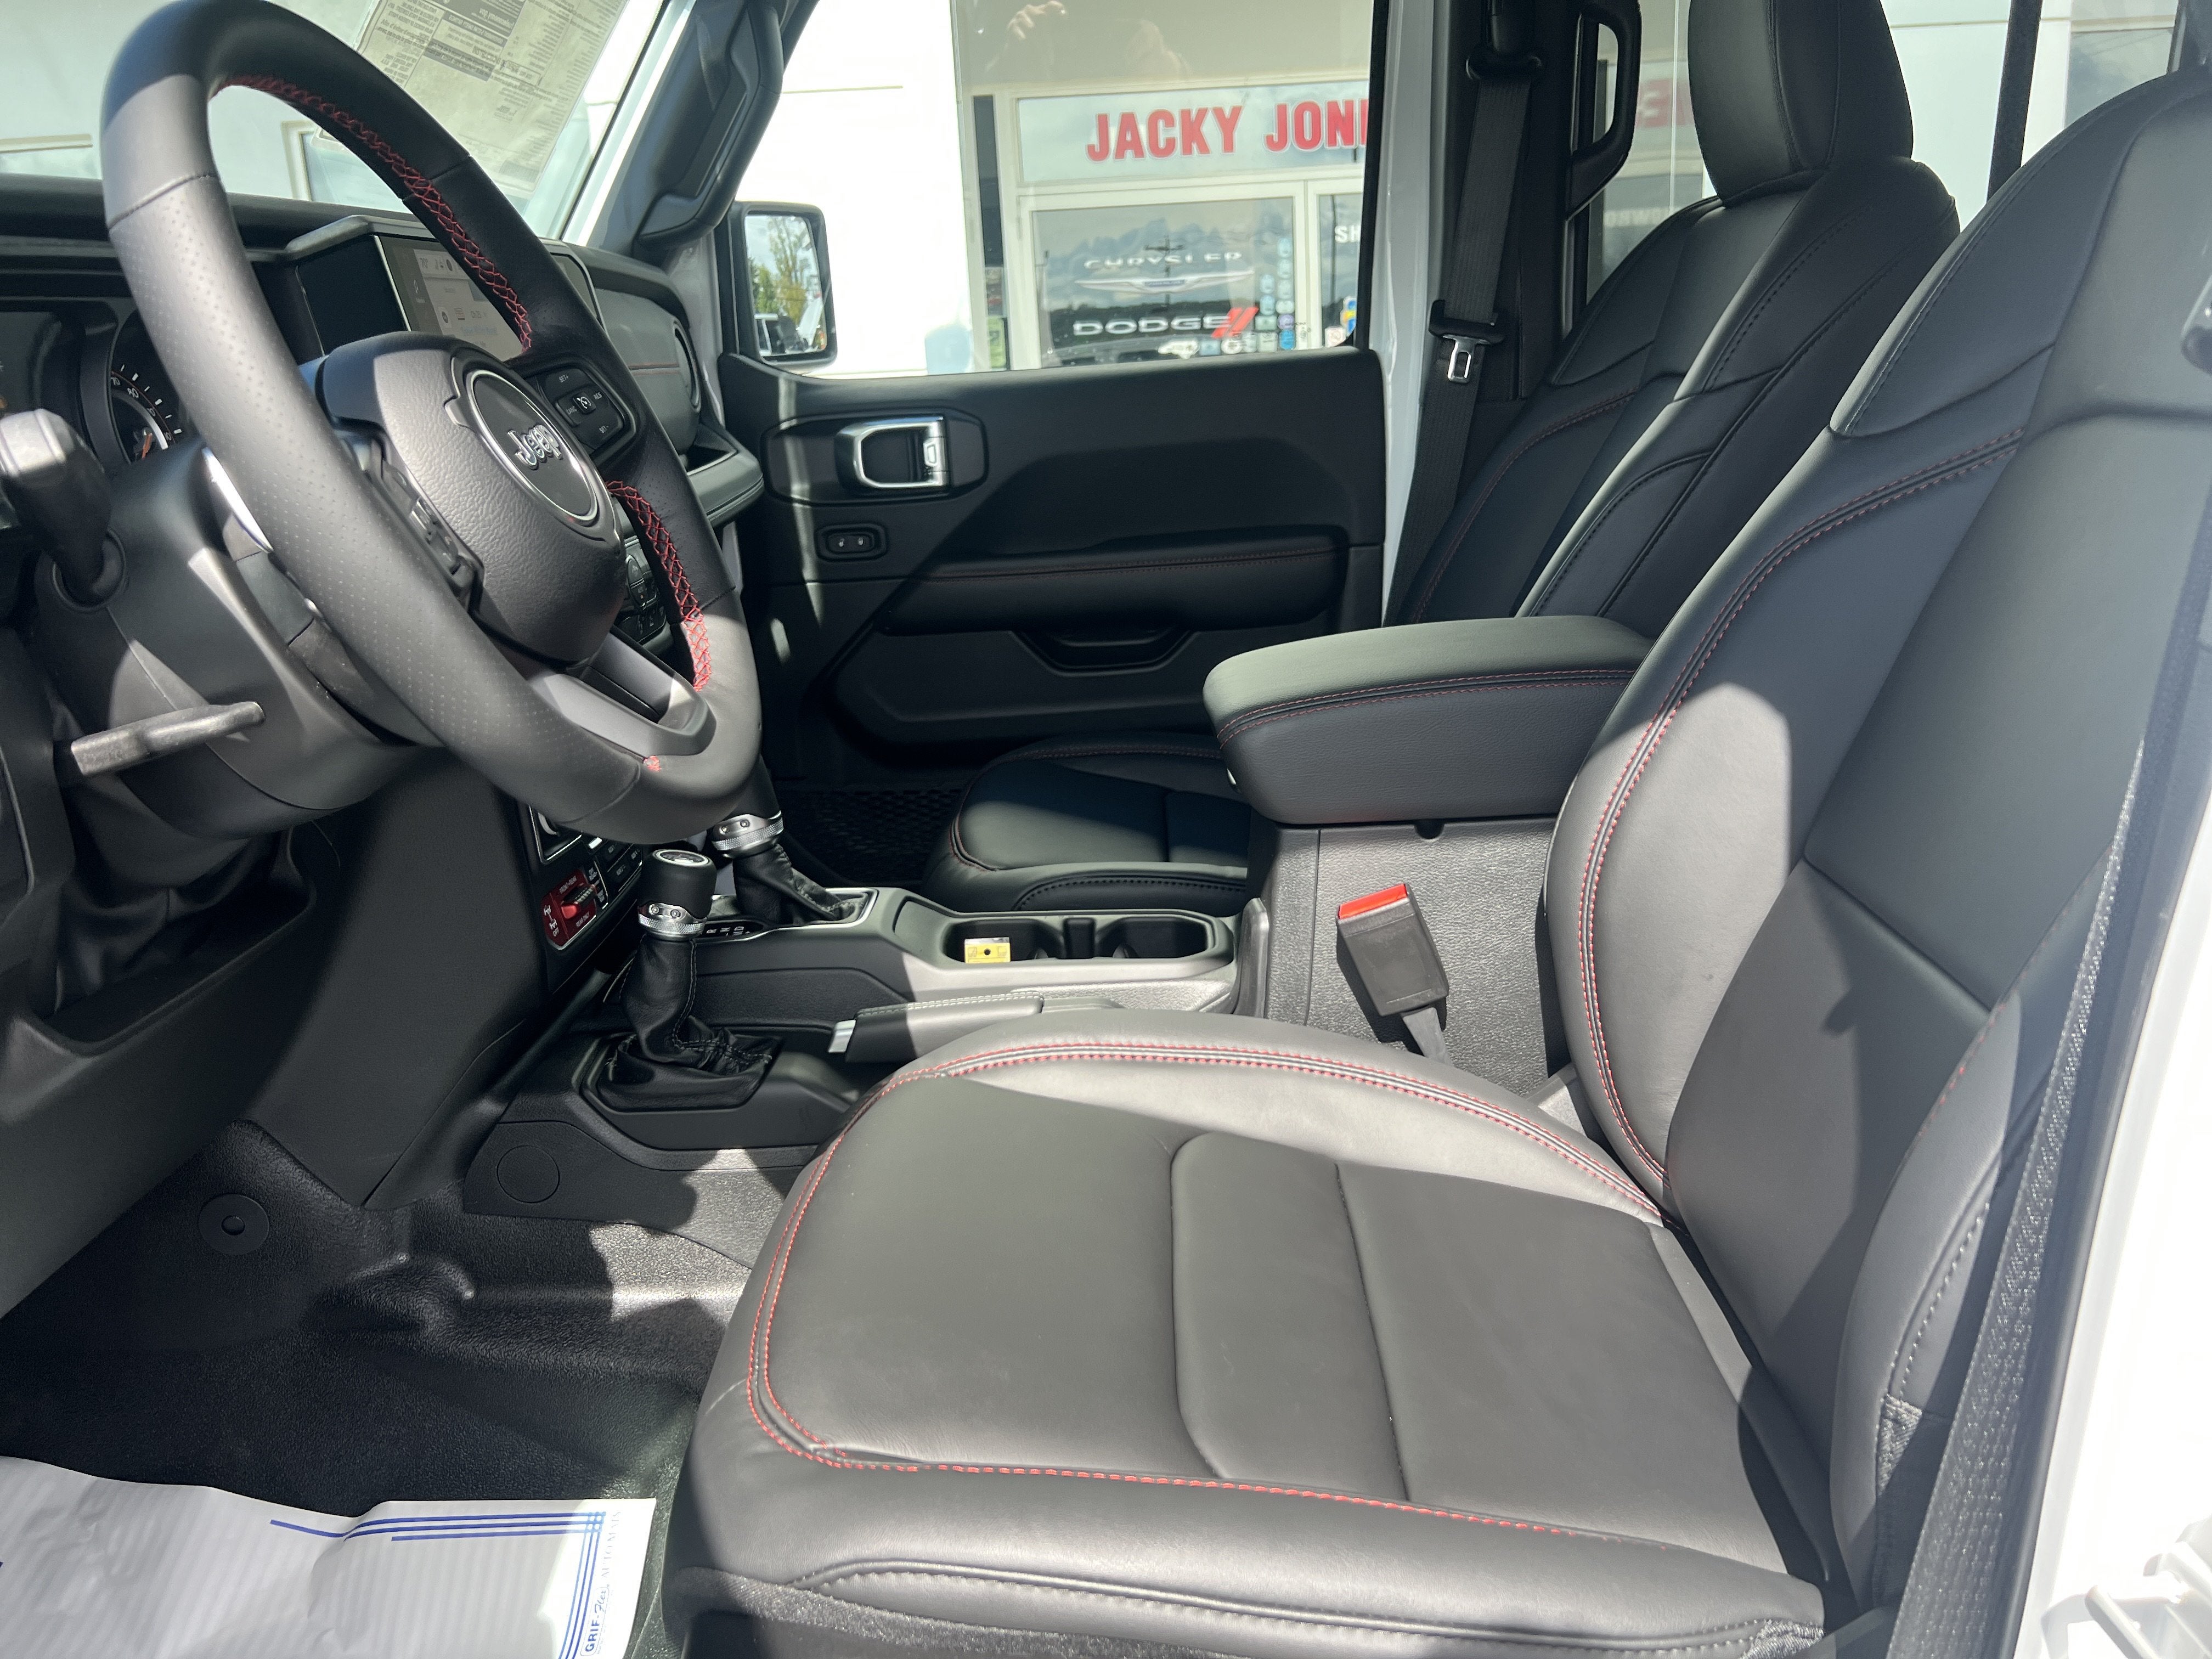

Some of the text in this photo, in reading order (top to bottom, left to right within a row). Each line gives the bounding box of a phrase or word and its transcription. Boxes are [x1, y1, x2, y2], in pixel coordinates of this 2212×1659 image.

[1086, 98, 1368, 162] JACKY JON
[1084, 251, 1242, 269] CHRYSLER
[1073, 315, 1231, 336] DODGE
[507, 424, 561, 466] Jeep
